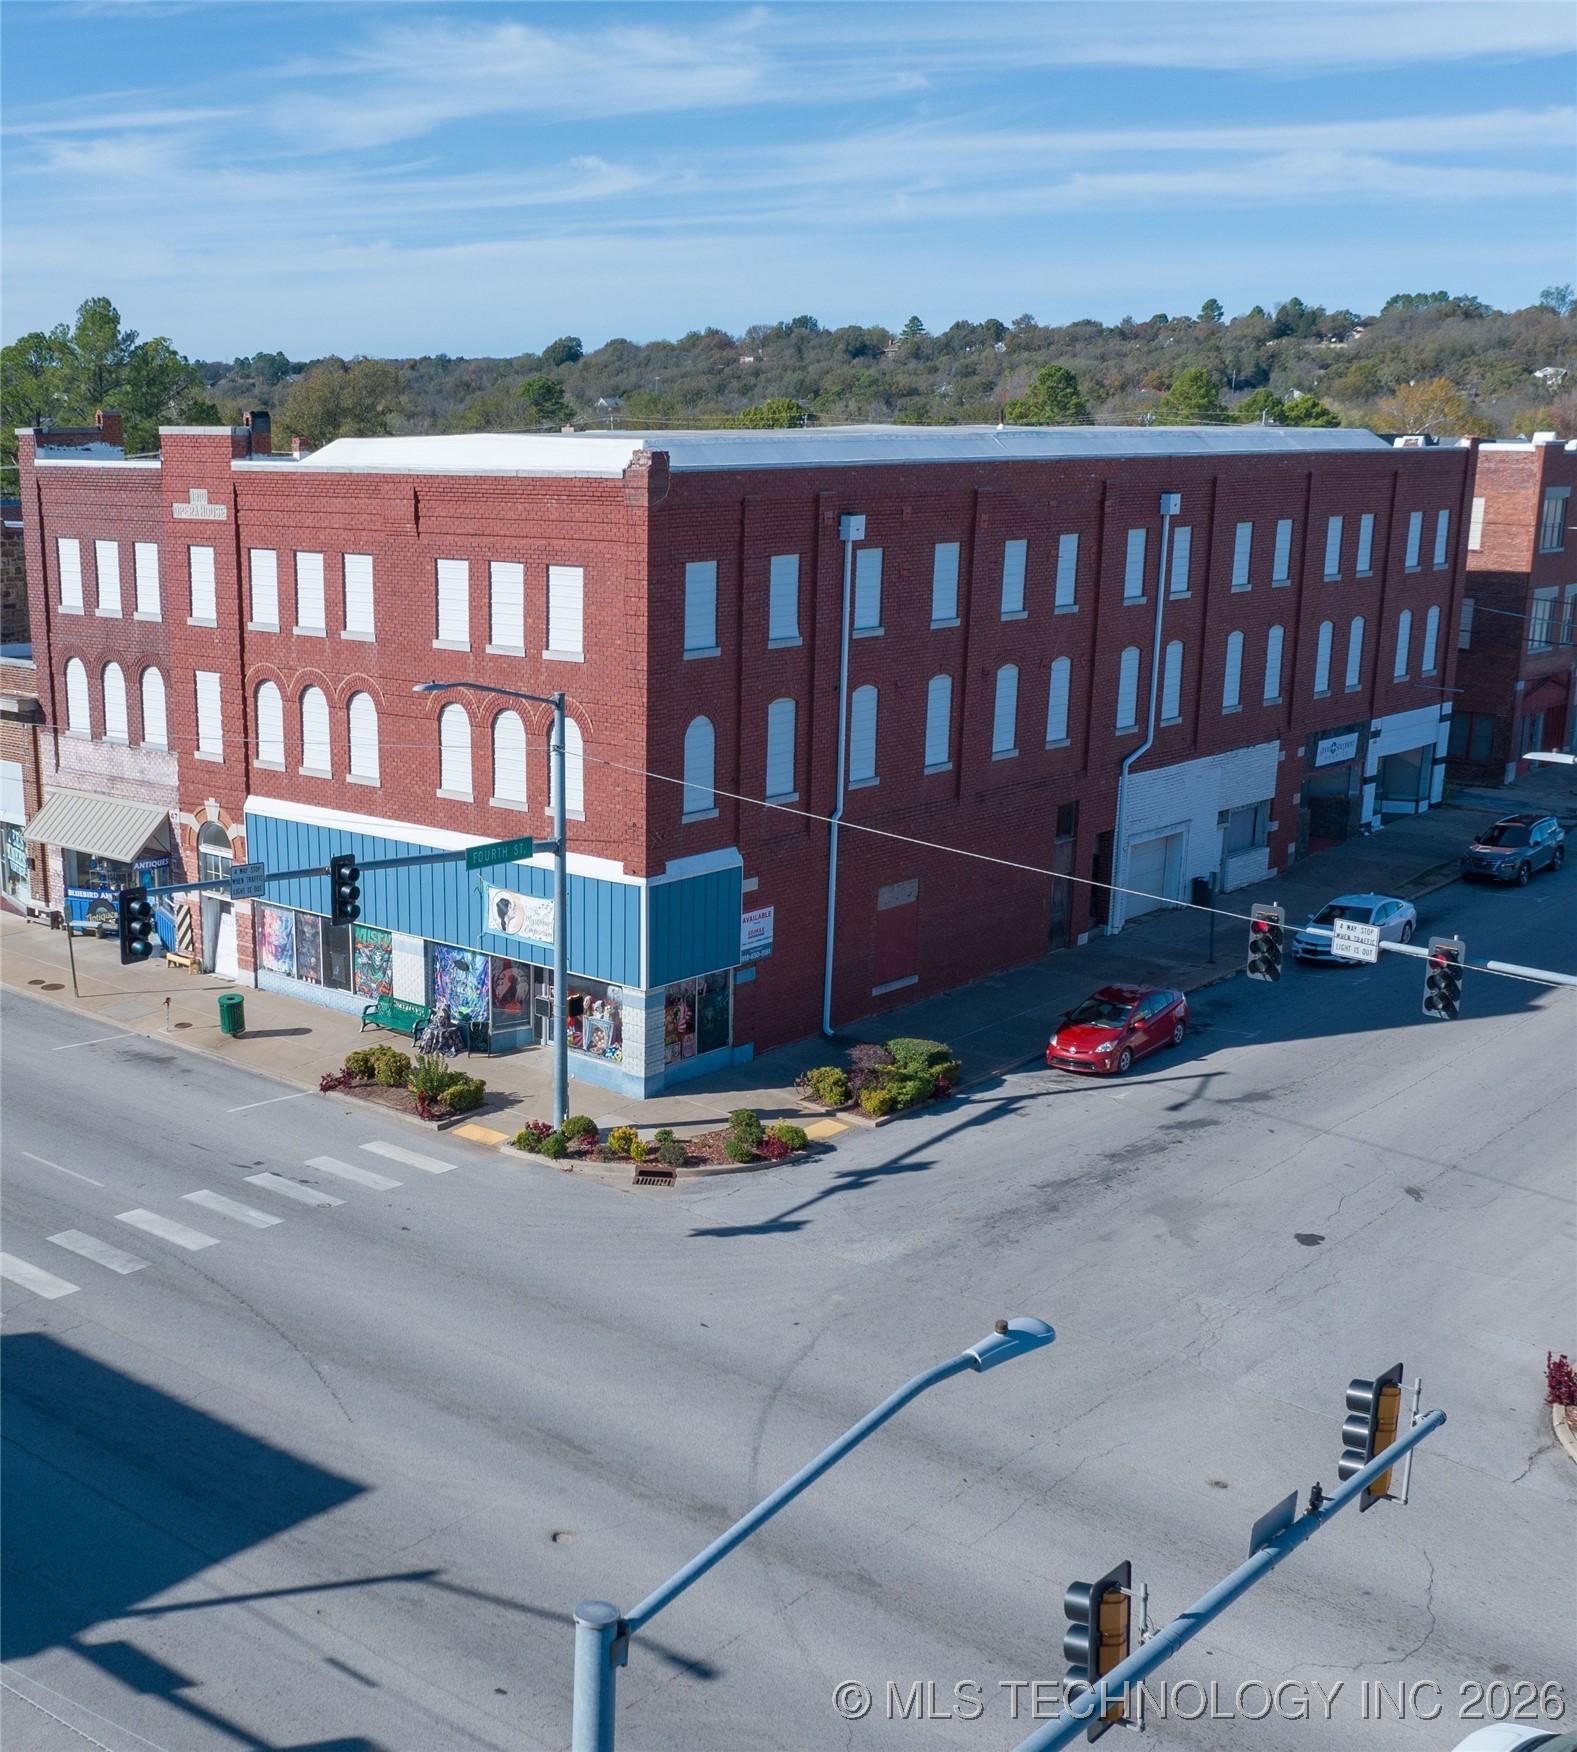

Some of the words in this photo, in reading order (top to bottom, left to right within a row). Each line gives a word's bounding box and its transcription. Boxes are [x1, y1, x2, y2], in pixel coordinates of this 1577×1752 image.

[472, 846, 508, 864] FOURTH
[513, 843, 527, 856] ST.
[133, 858, 169, 870] ANTIQUES
[240, 867, 248, 875] WAY
[250, 865, 261, 874] STOP
[245, 874, 264, 883] TRAFFIC
[67, 889, 99, 899] BLUEBIRD
[232, 887, 246, 896] LIGHT
[247, 886, 252, 894] IS
[253, 885, 262, 893] OUT
[742, 911, 772, 925] AVAILABLE
[1346, 924, 1357, 932] WAY
[1360, 927, 1374, 935] STOP
[1353, 935, 1376, 945] TRAFFIC
[1335, 943, 1351, 952] LIGHT
[1353, 946, 1360, 954] IS
[1361, 948, 1373, 956] OUT
